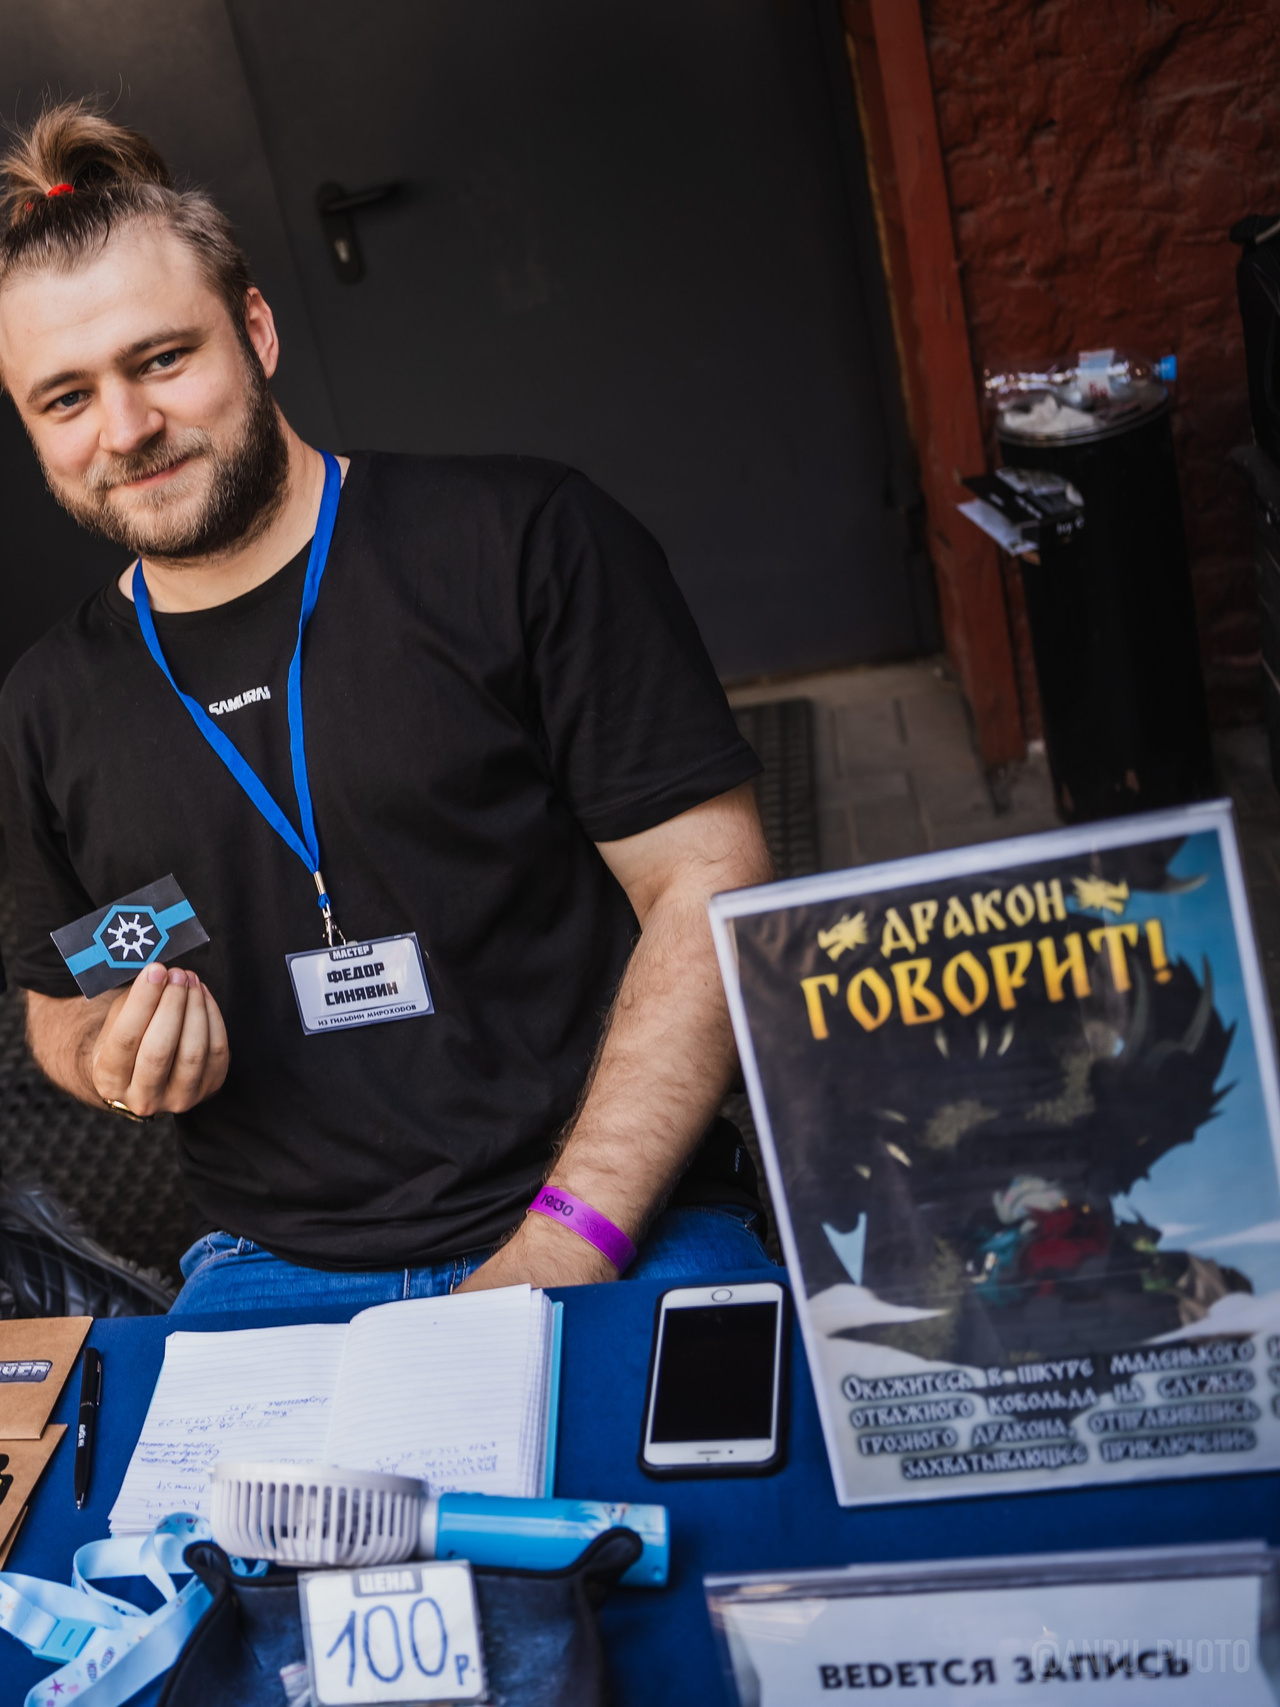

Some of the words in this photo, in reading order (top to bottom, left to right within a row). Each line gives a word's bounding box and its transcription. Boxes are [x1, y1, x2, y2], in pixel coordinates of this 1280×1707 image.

[880, 878, 1066, 957] ДРАКОН
[332, 945, 370, 960] МАСТЕР
[326, 962, 385, 984] ФЕДОР
[800, 919, 1172, 1040] ГОВОРИТ!
[324, 981, 399, 1006] СИНЯВИН
[359, 1570, 416, 1594] ЦЕНА
[1013, 1648, 1192, 1684] ЗАПИСЬ
